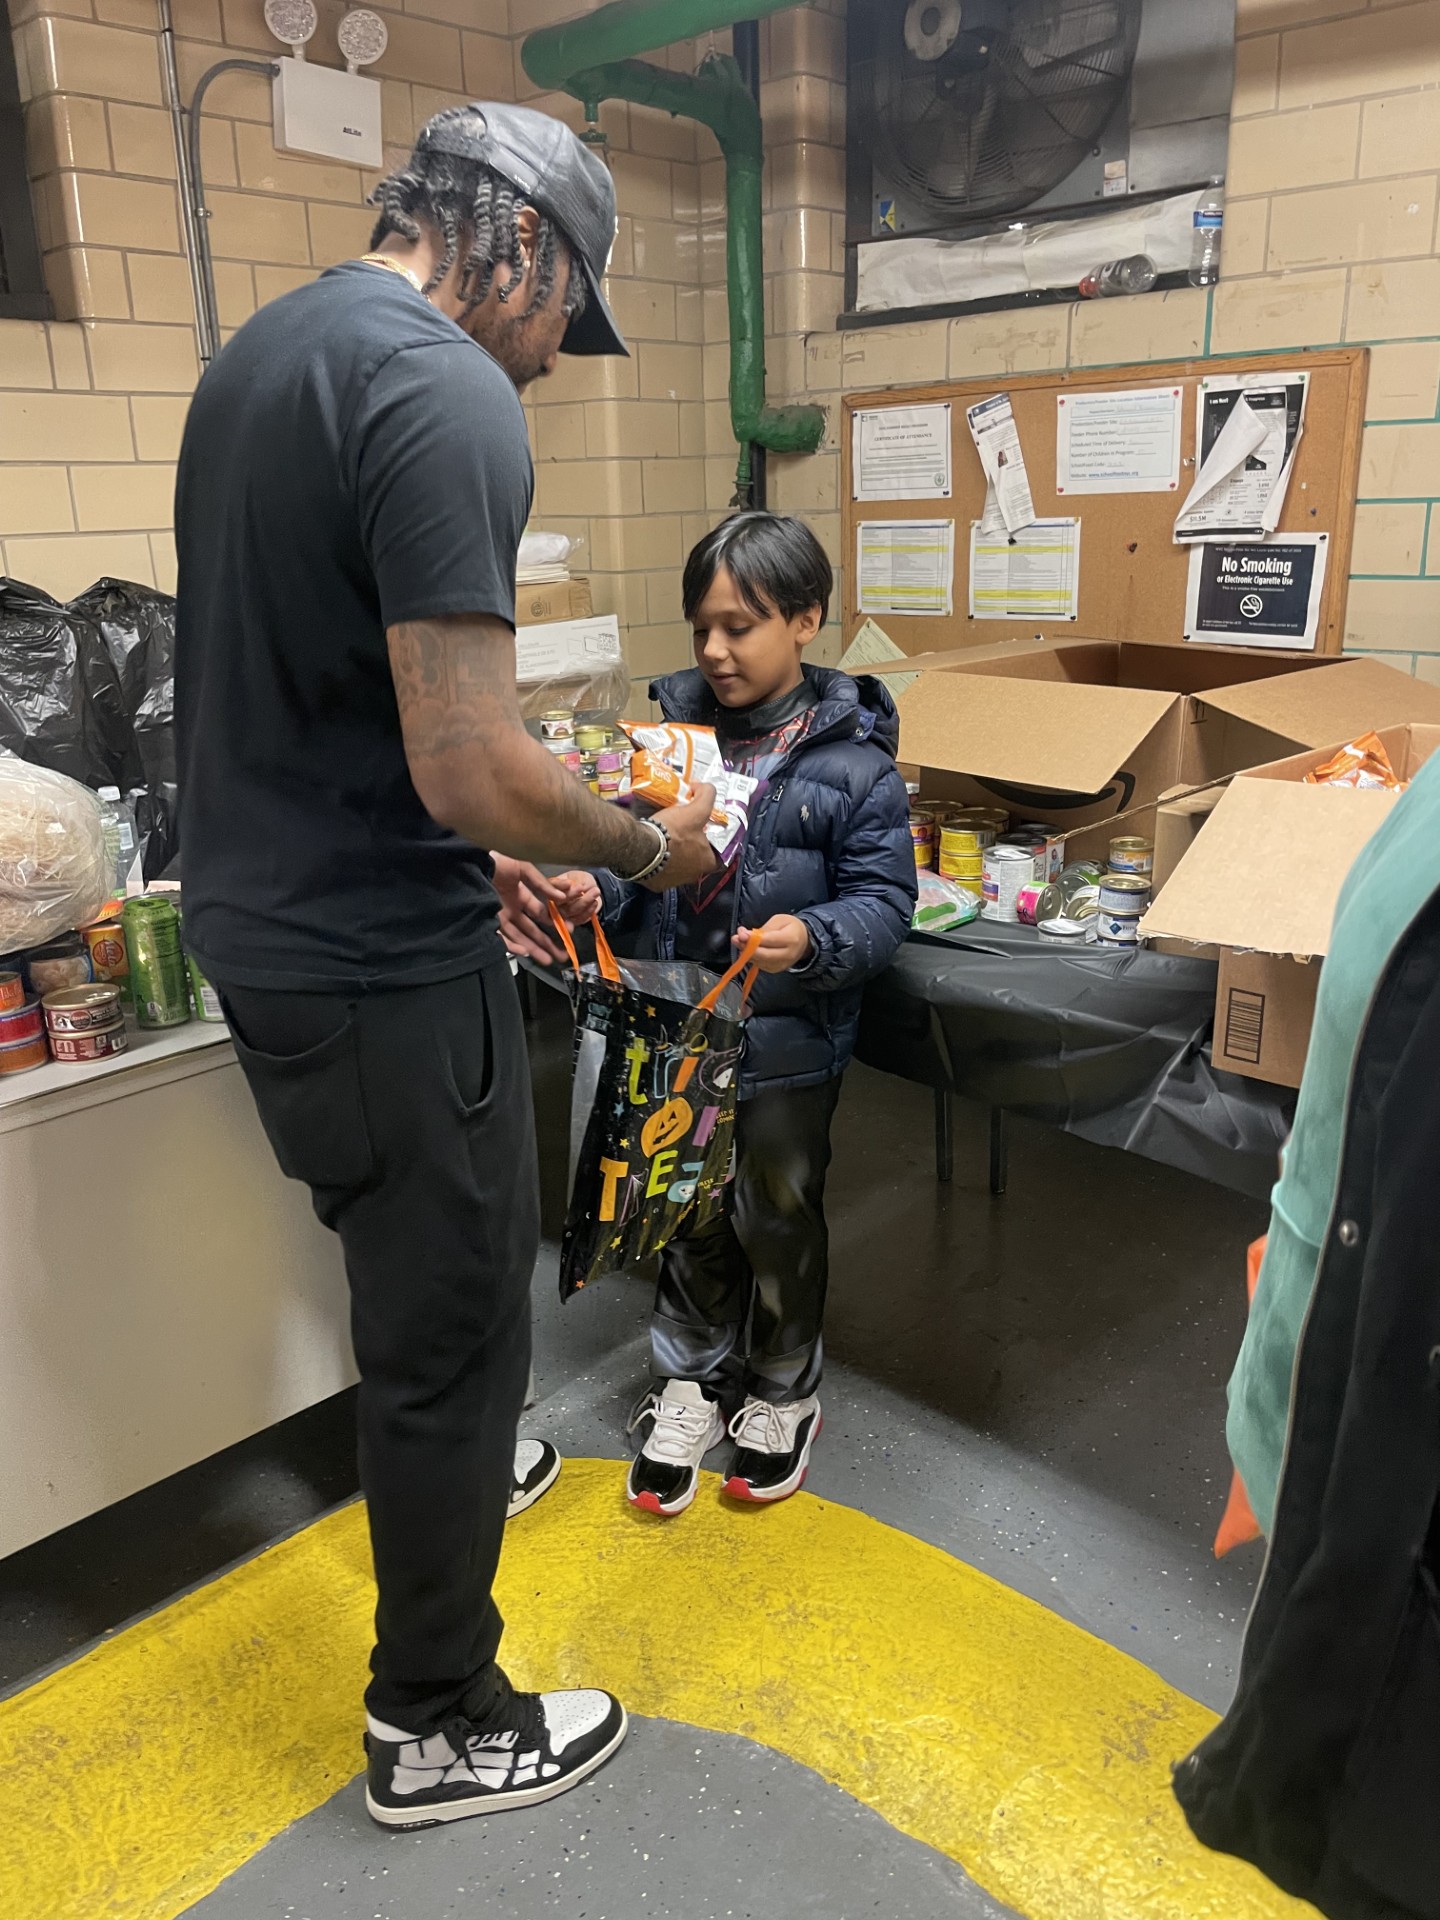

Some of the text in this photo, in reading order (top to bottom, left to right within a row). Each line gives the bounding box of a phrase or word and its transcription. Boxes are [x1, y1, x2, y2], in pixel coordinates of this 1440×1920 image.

[1221, 556, 1293, 577] No Smoking
[1216, 574, 1294, 586] or Electronic Cigarette Use
